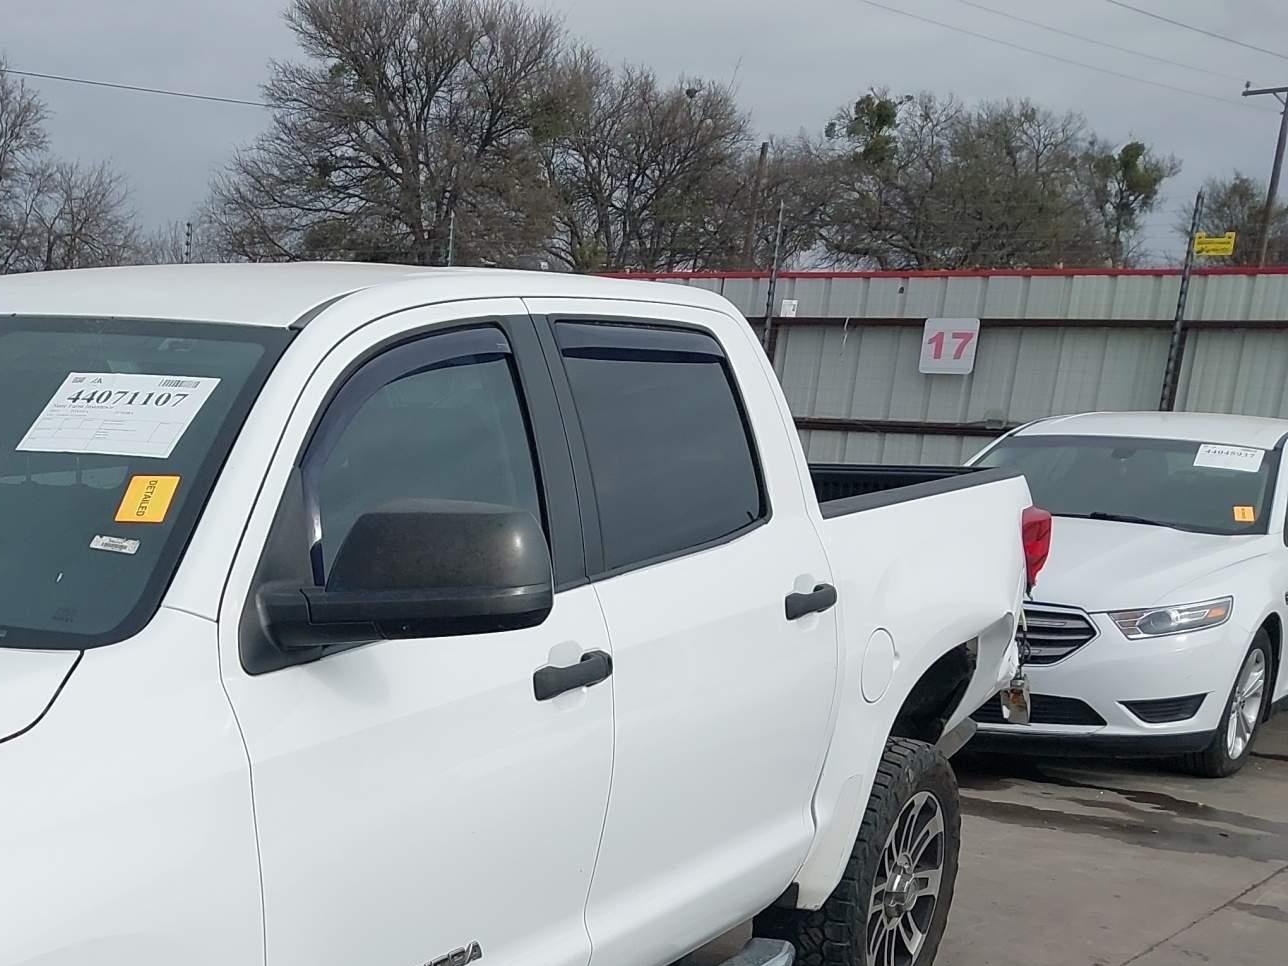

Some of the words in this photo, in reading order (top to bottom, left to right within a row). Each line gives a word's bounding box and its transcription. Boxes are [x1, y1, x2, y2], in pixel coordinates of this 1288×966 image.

[927, 331, 974, 360] 17
[67, 390, 189, 407] 44071107
[135, 479, 159, 517] DETAILED
